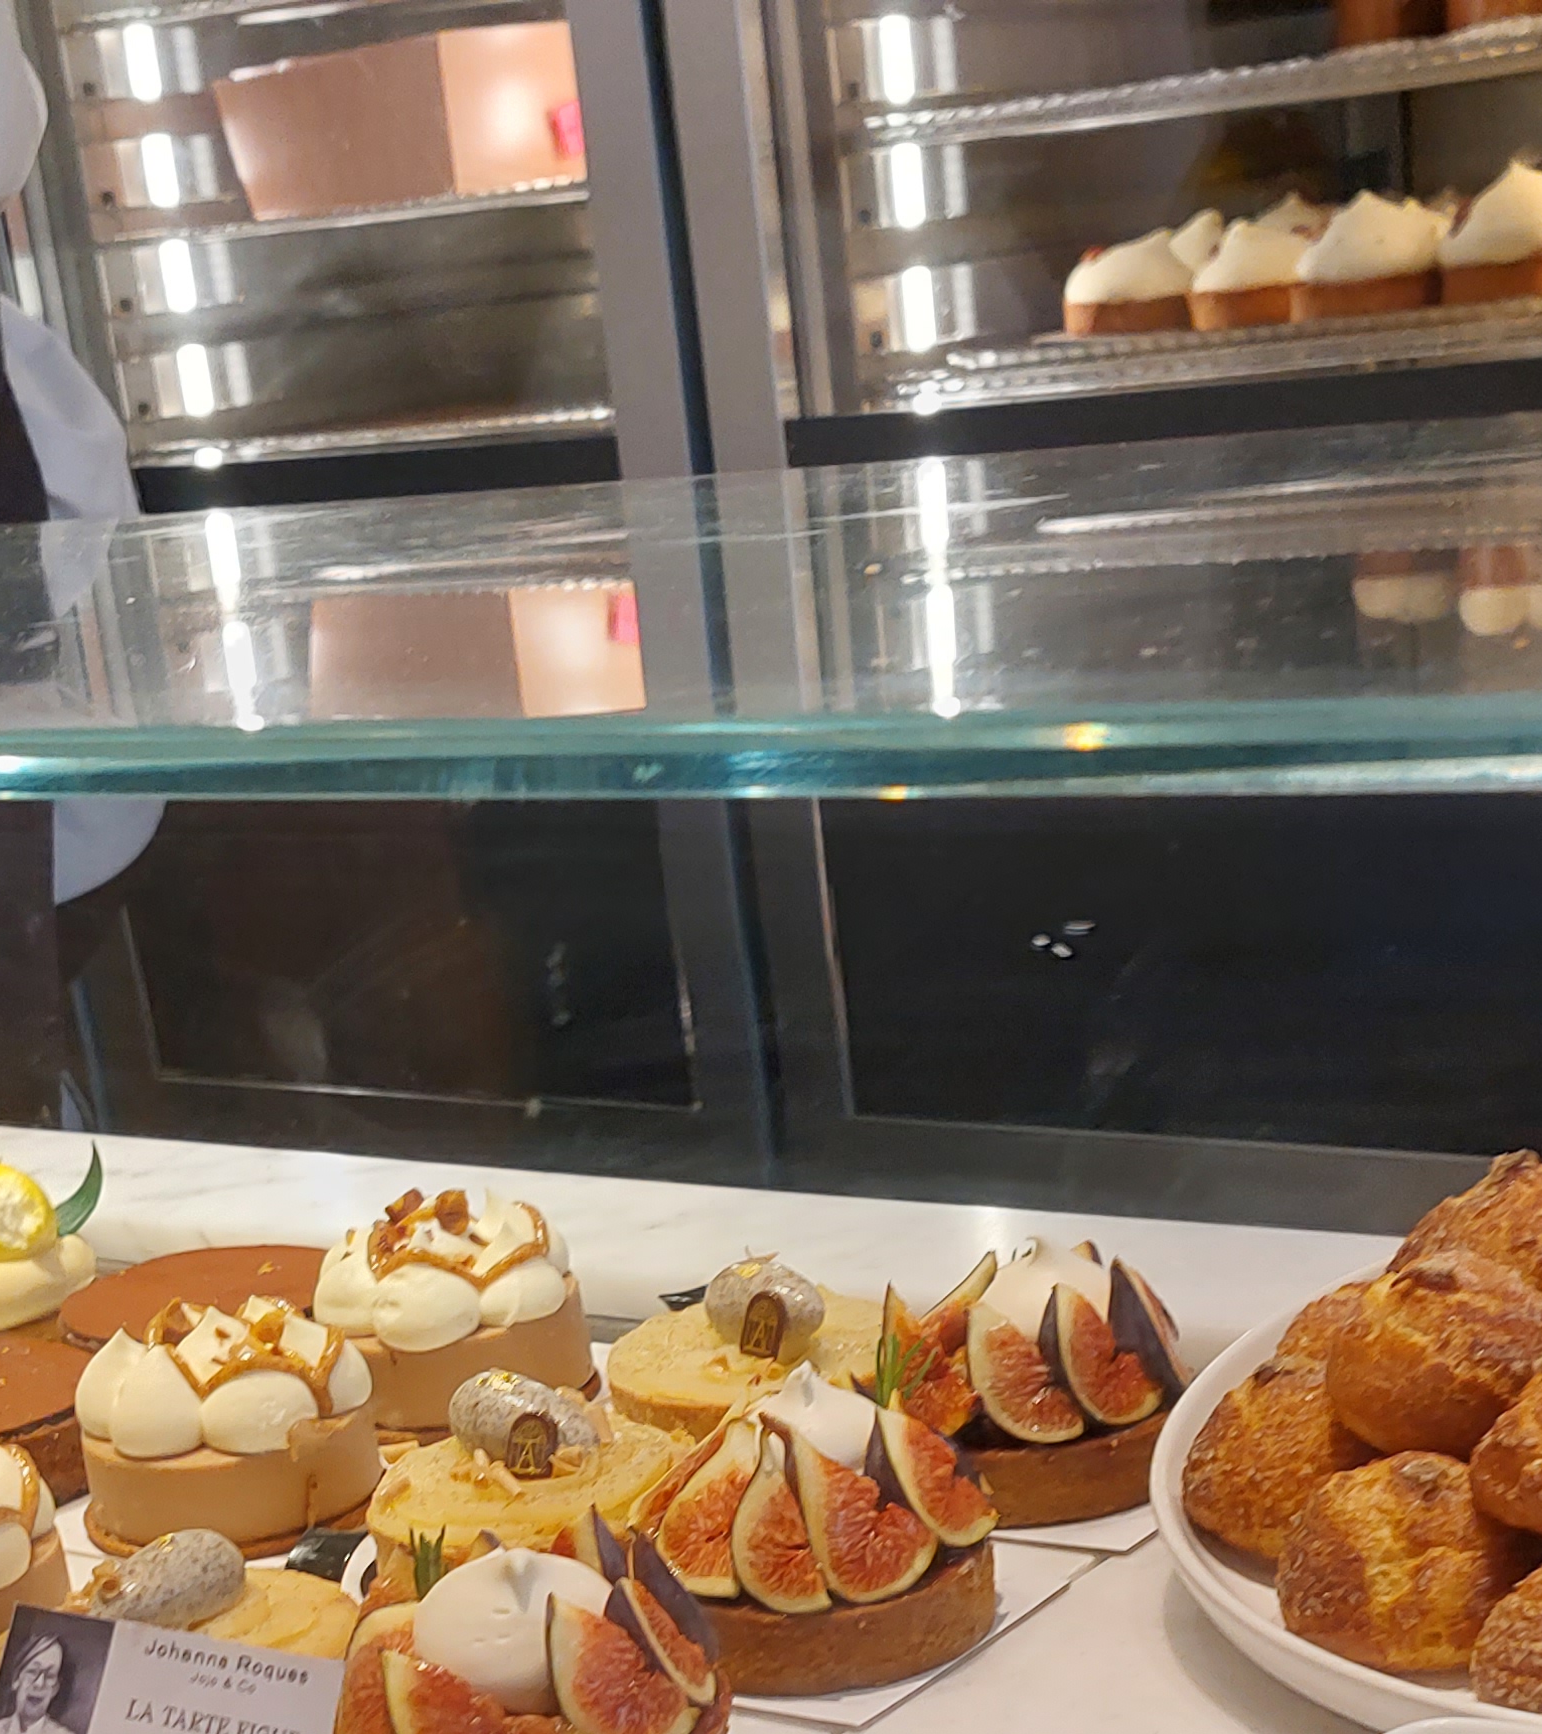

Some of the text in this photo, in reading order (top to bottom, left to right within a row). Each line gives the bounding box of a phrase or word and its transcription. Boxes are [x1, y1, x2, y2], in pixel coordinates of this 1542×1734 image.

[144, 1640, 308, 1685] Johanna Roques
[189, 1672, 257, 1696] Jojo & Co
[125, 1698, 153, 1723] LA
